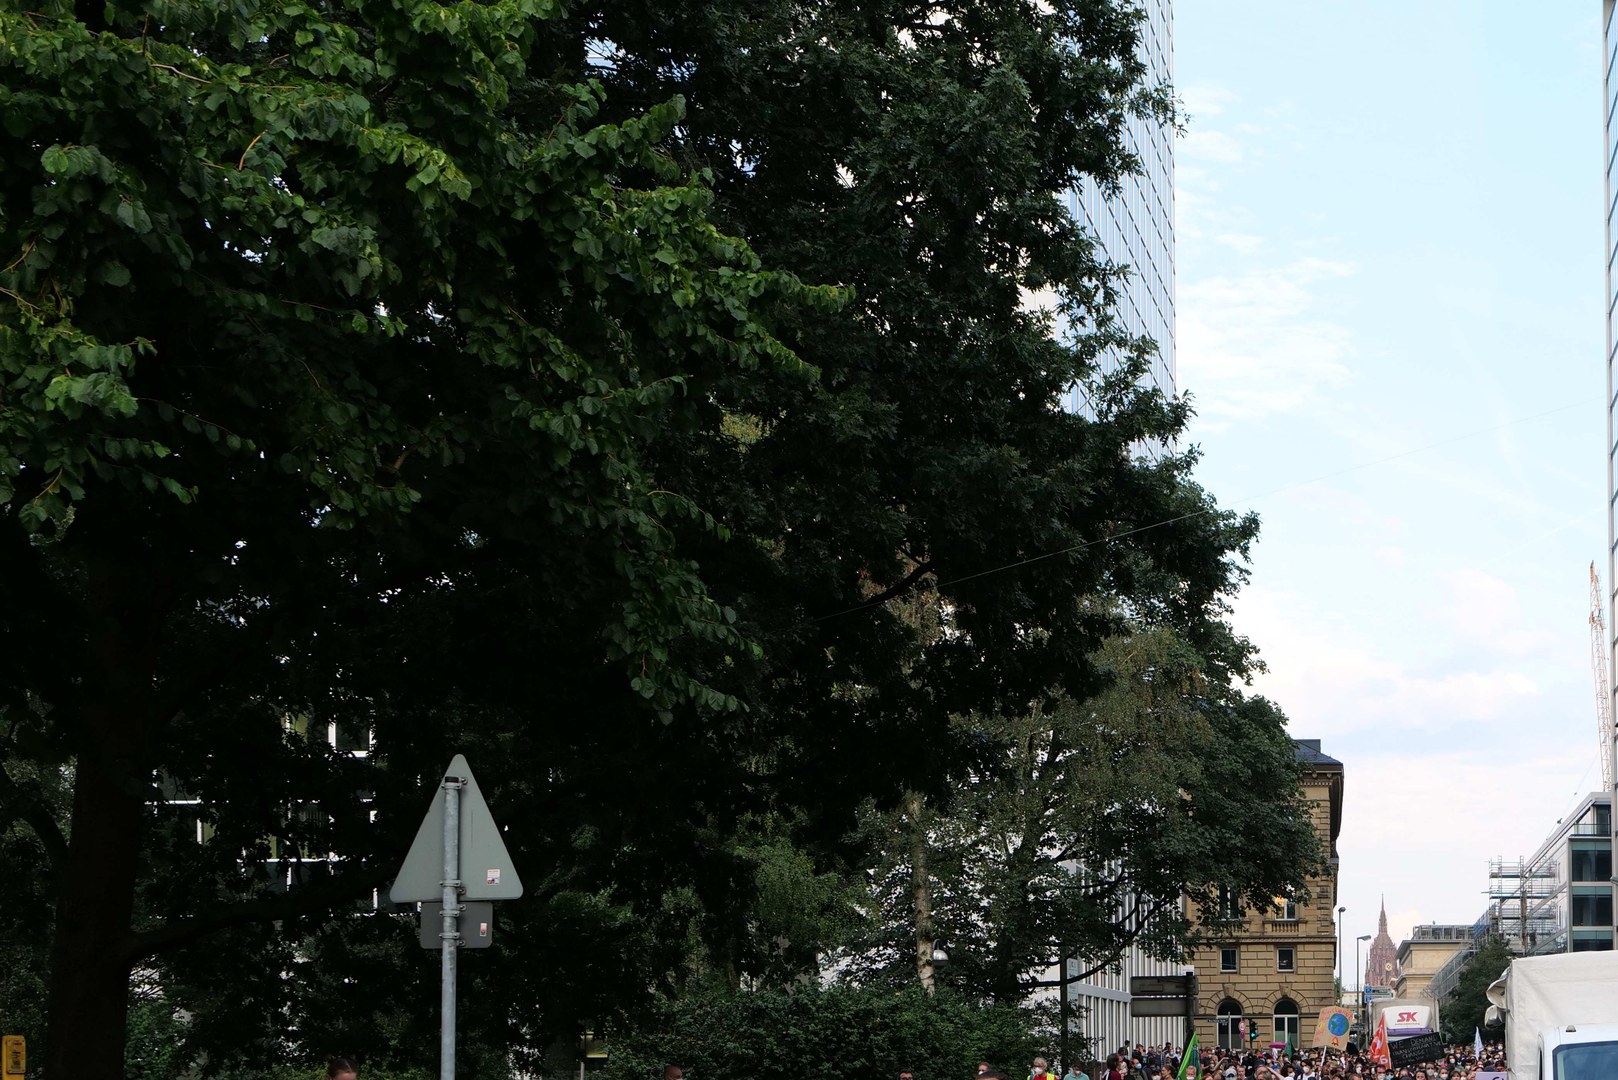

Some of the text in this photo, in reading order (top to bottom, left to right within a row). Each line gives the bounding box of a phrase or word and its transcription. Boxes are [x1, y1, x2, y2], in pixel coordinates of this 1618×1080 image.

[1397, 1011, 1418, 1022] SK
[1391, 1034, 1438, 1050] WE DEMAND
